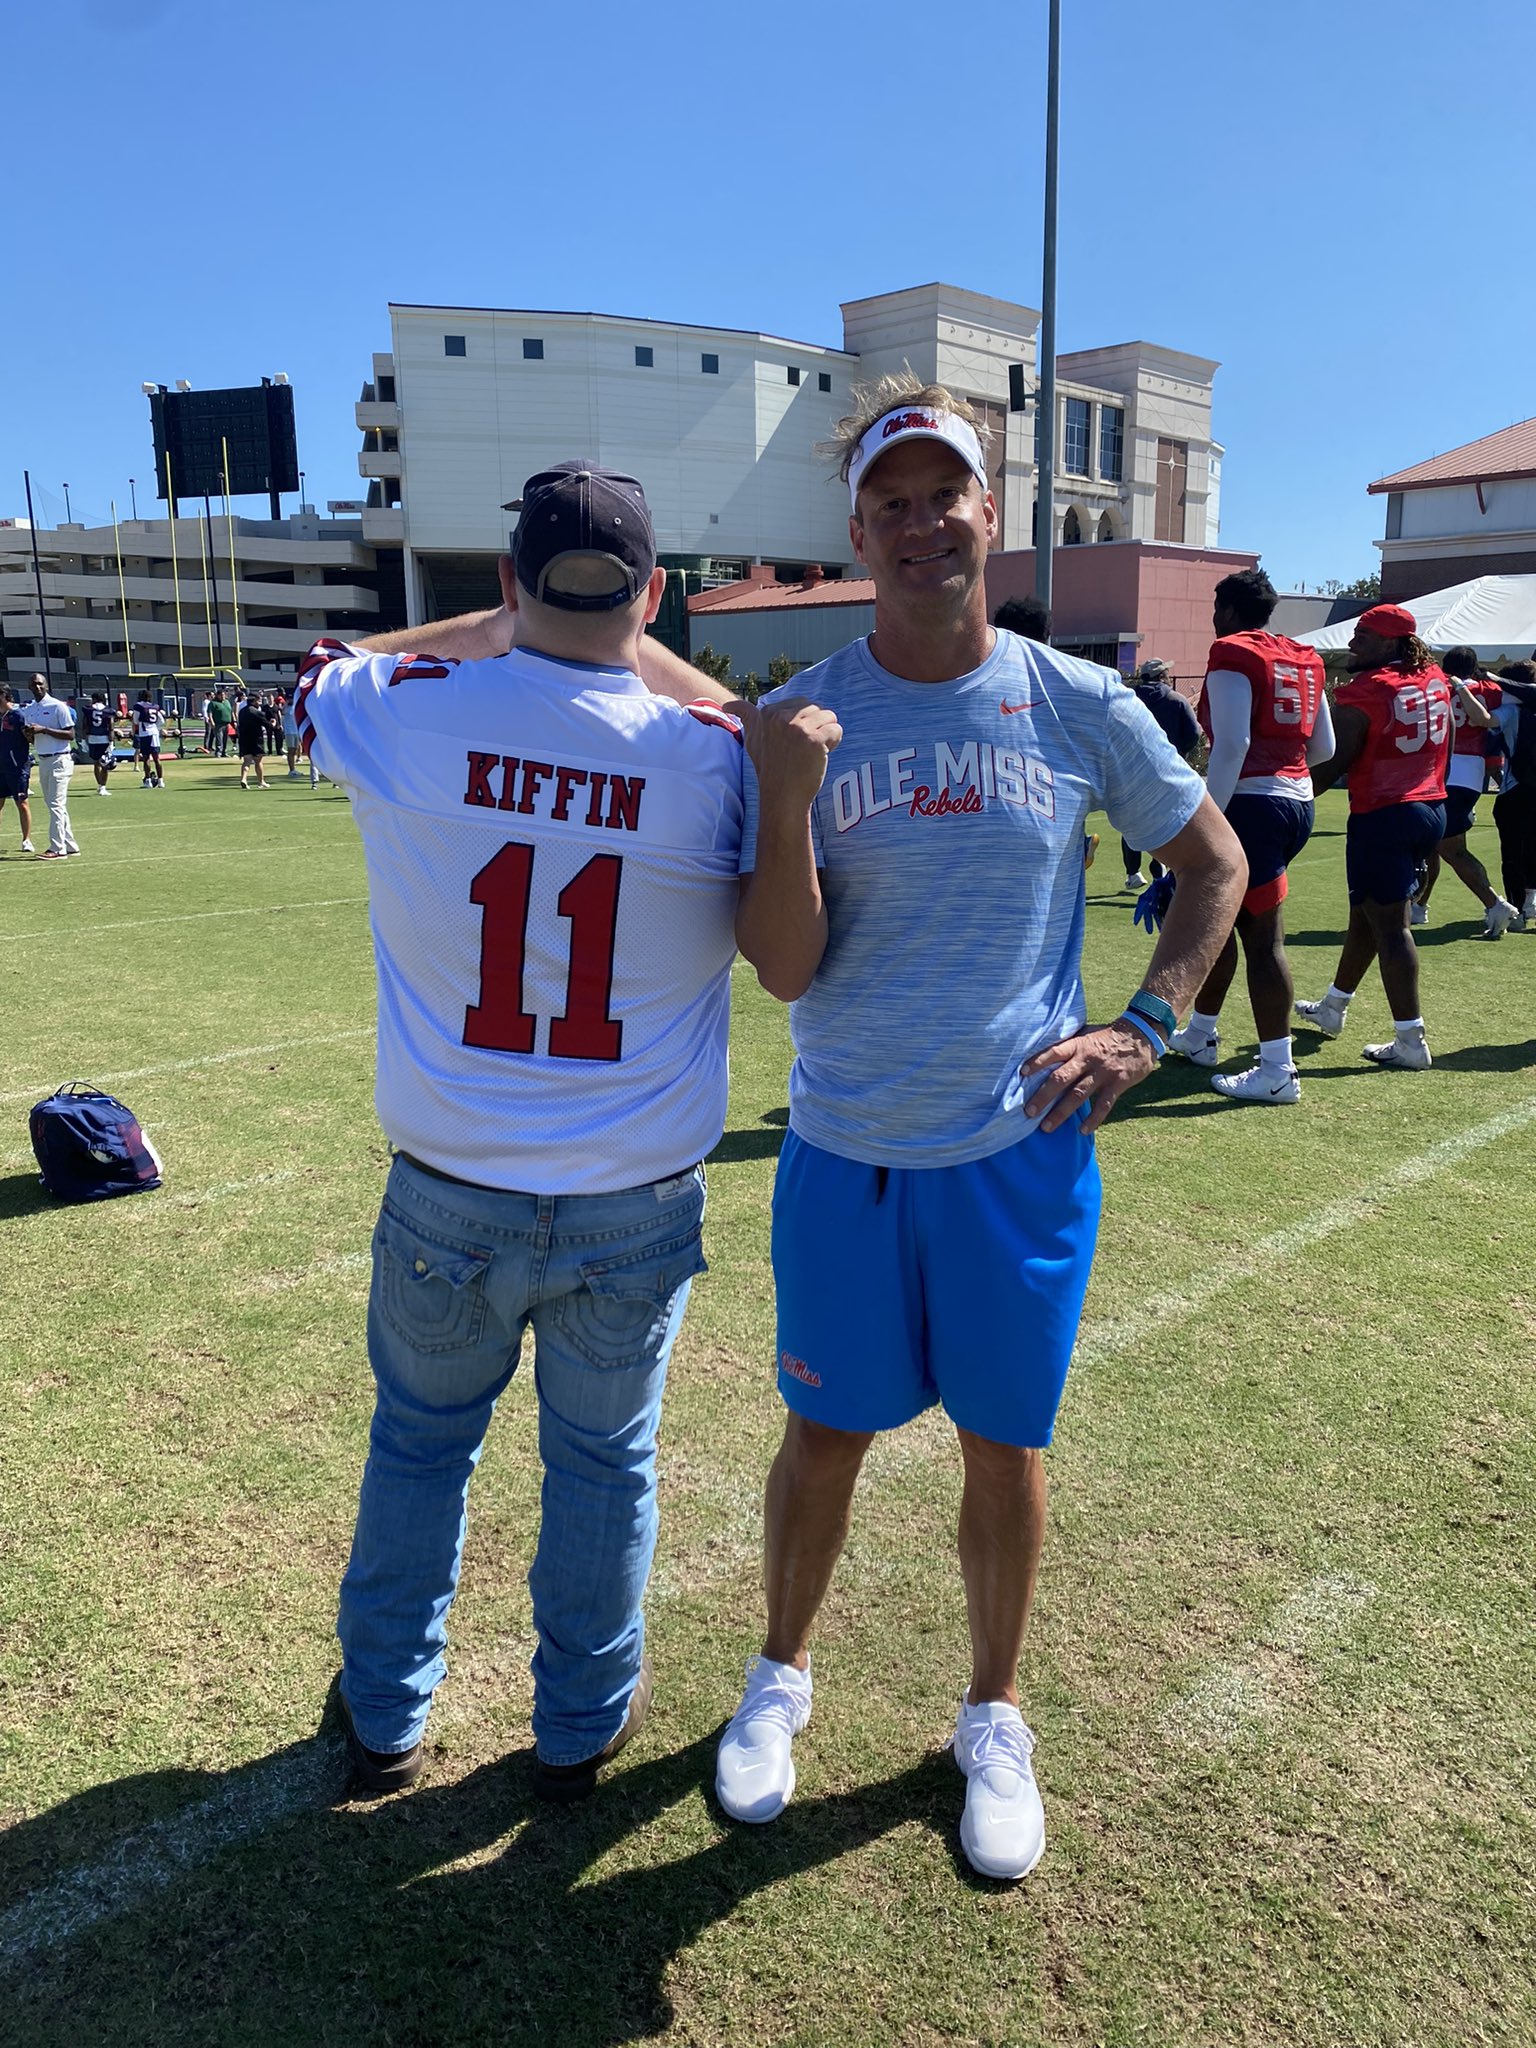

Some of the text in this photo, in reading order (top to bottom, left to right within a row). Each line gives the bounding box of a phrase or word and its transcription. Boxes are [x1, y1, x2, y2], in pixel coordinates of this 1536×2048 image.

[92, 710, 103, 727] 5
[148, 708, 157, 723] 5
[1273, 661, 1316, 725] 51
[1393, 678, 1449, 754] 96
[463, 750, 646, 832] KIFFIN
[832, 740, 1056, 833] OLE MISS
[909, 784, 985, 818] Rebels
[462, 841, 623, 1061] 11
